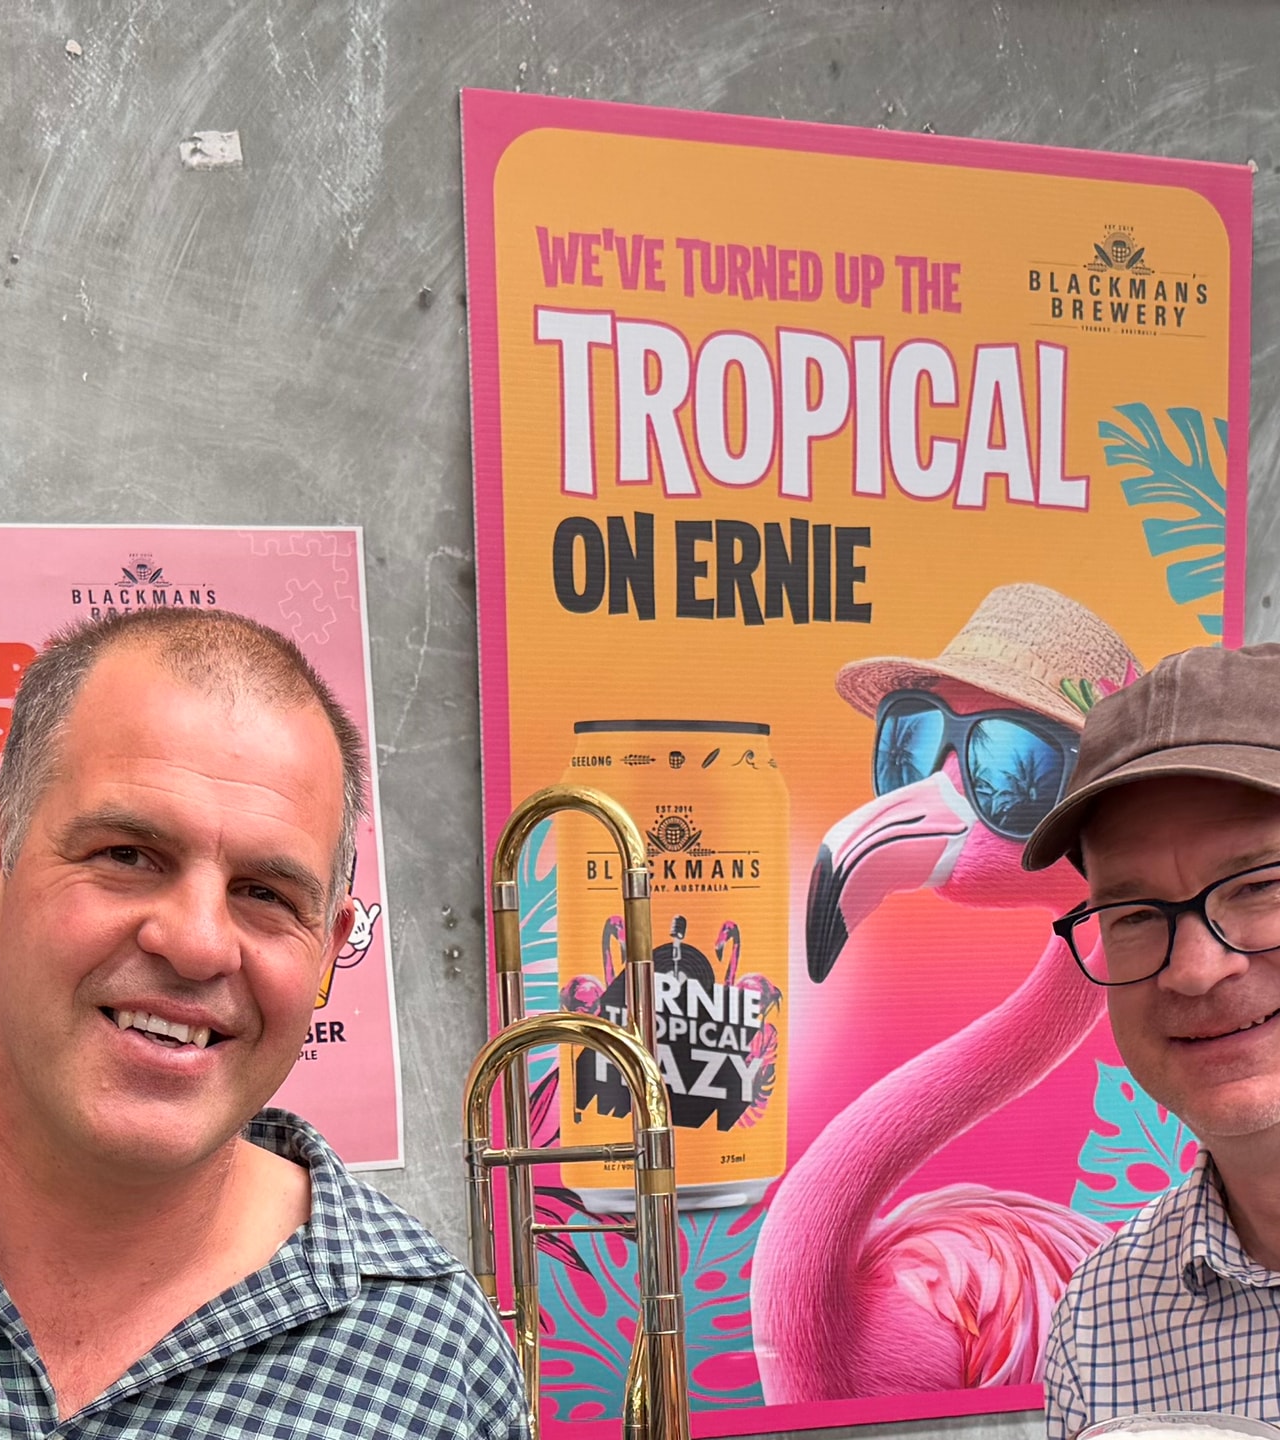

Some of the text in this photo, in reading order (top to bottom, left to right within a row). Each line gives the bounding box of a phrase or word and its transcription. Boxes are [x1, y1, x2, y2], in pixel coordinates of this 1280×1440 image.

[535, 225, 962, 314] WE'VE TURNED UP THE
[1051, 297, 1185, 328] BREWERY
[533, 304, 1090, 511] TROPICAL
[552, 511, 872, 626] ON ERNIE
[571, 755, 612, 767] GEELONG
[674, 884, 729, 892] AUSTRALIA
[654, 971, 762, 1029] RNIE
[720, 1154, 746, 1165] 375ml
